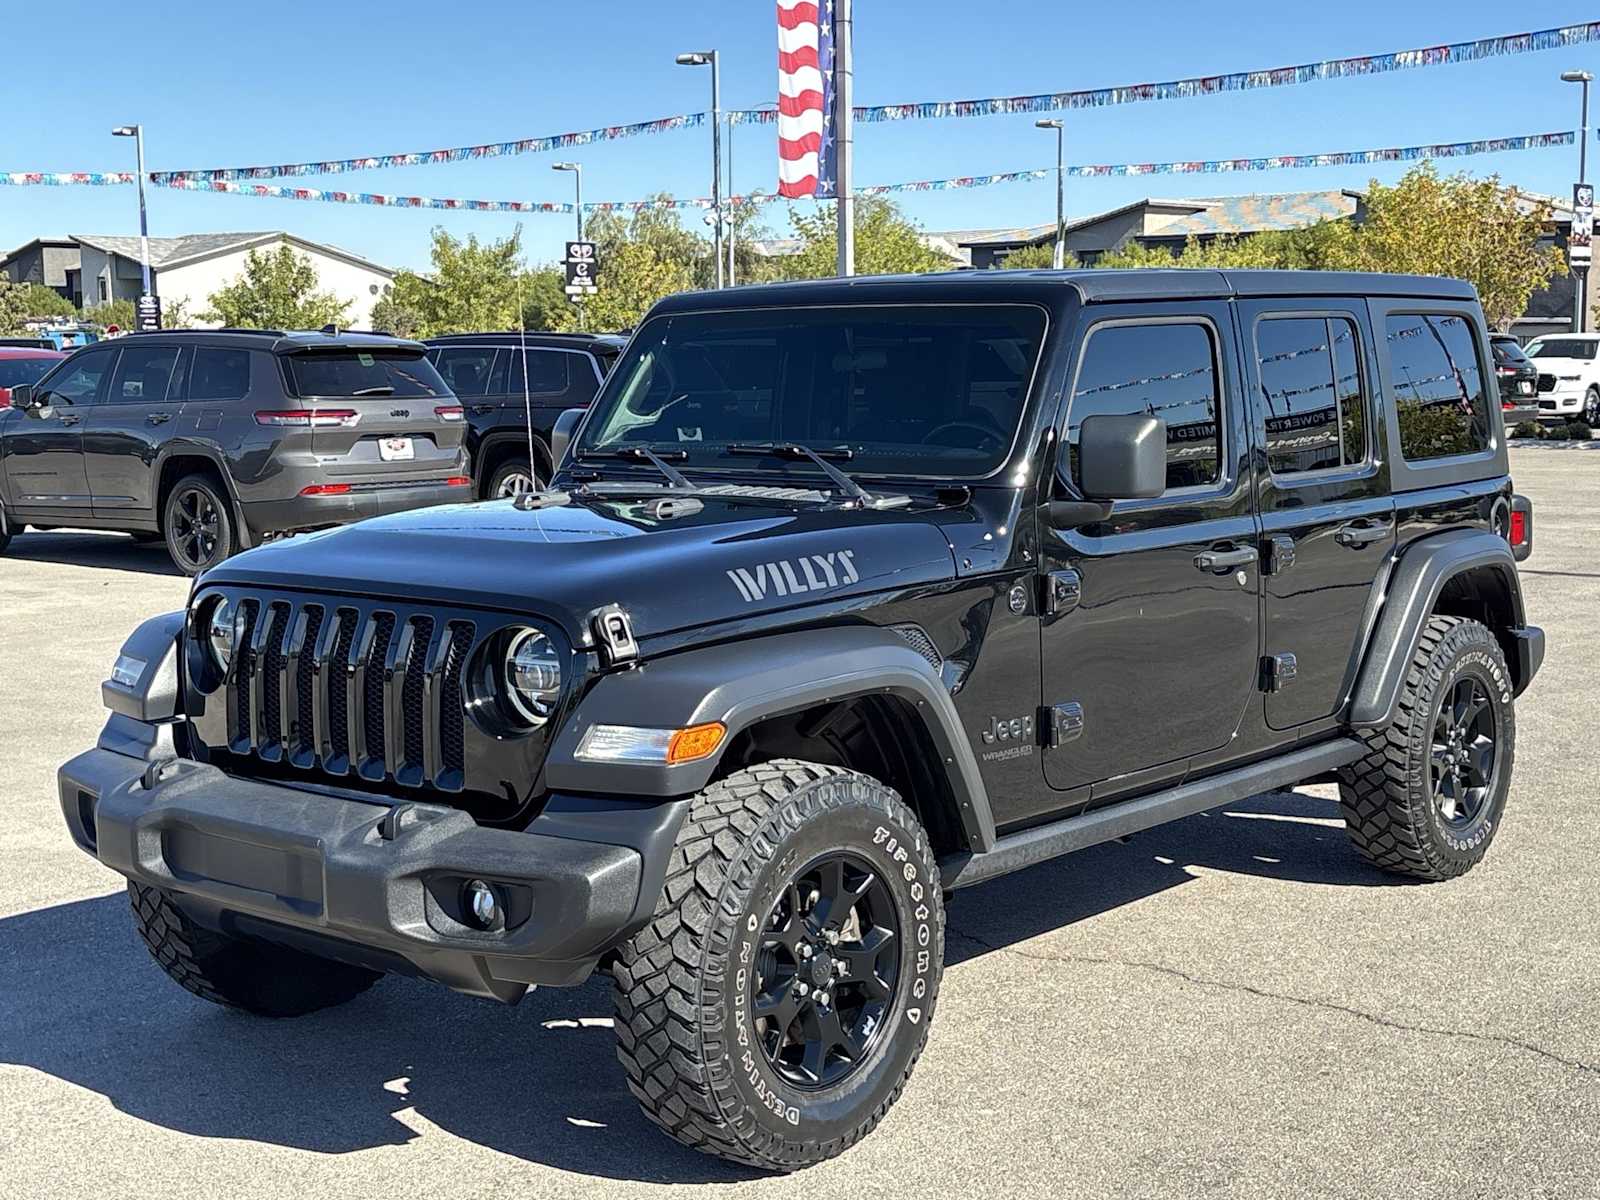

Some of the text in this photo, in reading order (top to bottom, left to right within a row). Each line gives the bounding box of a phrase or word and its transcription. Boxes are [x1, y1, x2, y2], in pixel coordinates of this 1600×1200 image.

[390, 409, 410, 418] Jeep
[726, 550, 859, 602] WILLYS
[982, 714, 1034, 745] Jeep
[982, 744, 1033, 760] WRANGLER
[735, 941, 800, 1125] DESTINATION
